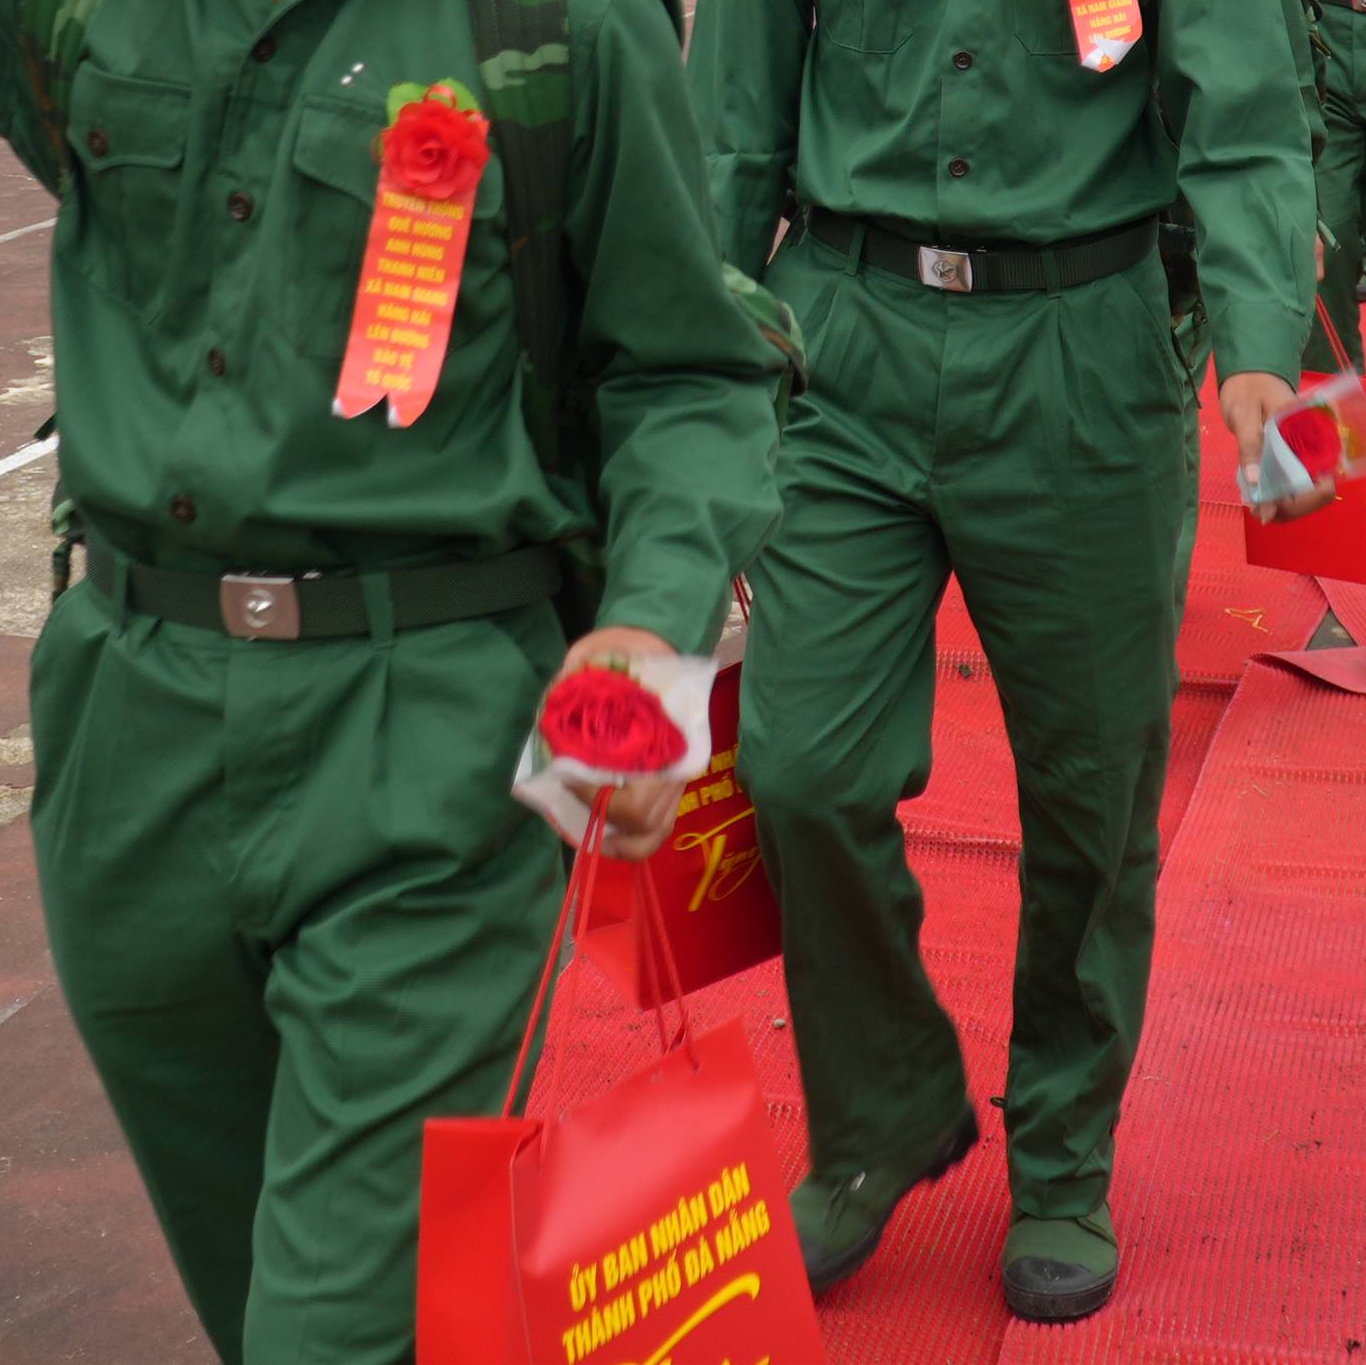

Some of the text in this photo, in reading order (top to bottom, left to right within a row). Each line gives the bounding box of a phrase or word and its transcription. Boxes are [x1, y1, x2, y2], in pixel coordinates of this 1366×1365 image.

[562, 1289, 636, 1365] THÀNH
[638, 1248, 682, 1318] PHỐ
[684, 1235, 715, 1287] ĐÀ
[715, 1199, 771, 1265] NẴNG
[570, 1161, 751, 1312] ỦY BAN NHÂN DÂN
